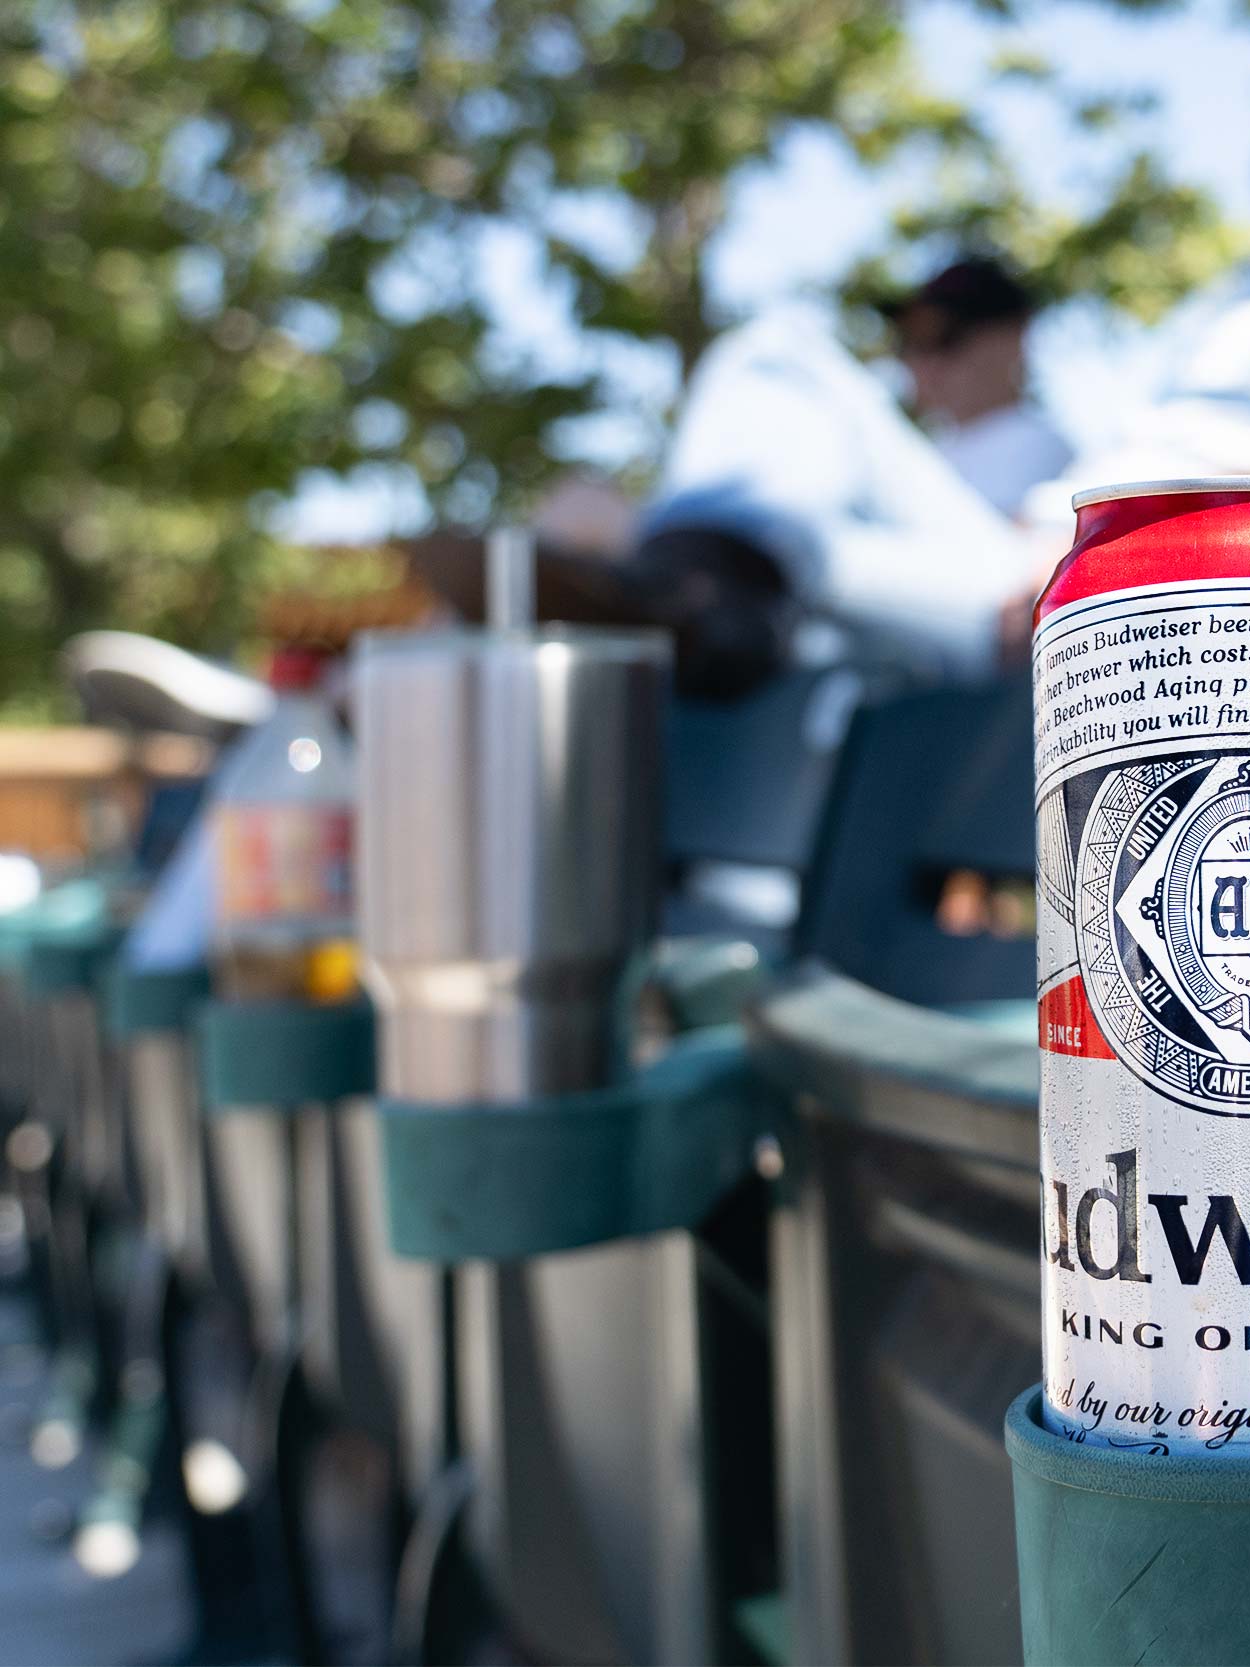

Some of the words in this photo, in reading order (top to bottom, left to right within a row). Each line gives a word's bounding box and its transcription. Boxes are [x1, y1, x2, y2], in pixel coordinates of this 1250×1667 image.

[1045, 640, 1089, 675] famous
[1094, 618, 1202, 651] Budweiser
[1067, 661, 1122, 689] brewer
[1129, 645, 1191, 672] which
[1054, 681, 1145, 727] Beechwood
[1154, 675, 1222, 700] Aging
[1041, 722, 1116, 768] drinkability
[1123, 715, 1161, 738] you
[1168, 706, 1208, 728] will
[1126, 796, 1179, 862] UNITED
[1136, 968, 1176, 1014] THE
[1046, 1022, 1082, 1048] SINCE
[1062, 1308, 1164, 1349] KING
[1076, 1380, 1108, 1431] by
[1114, 1402, 1172, 1426] our
